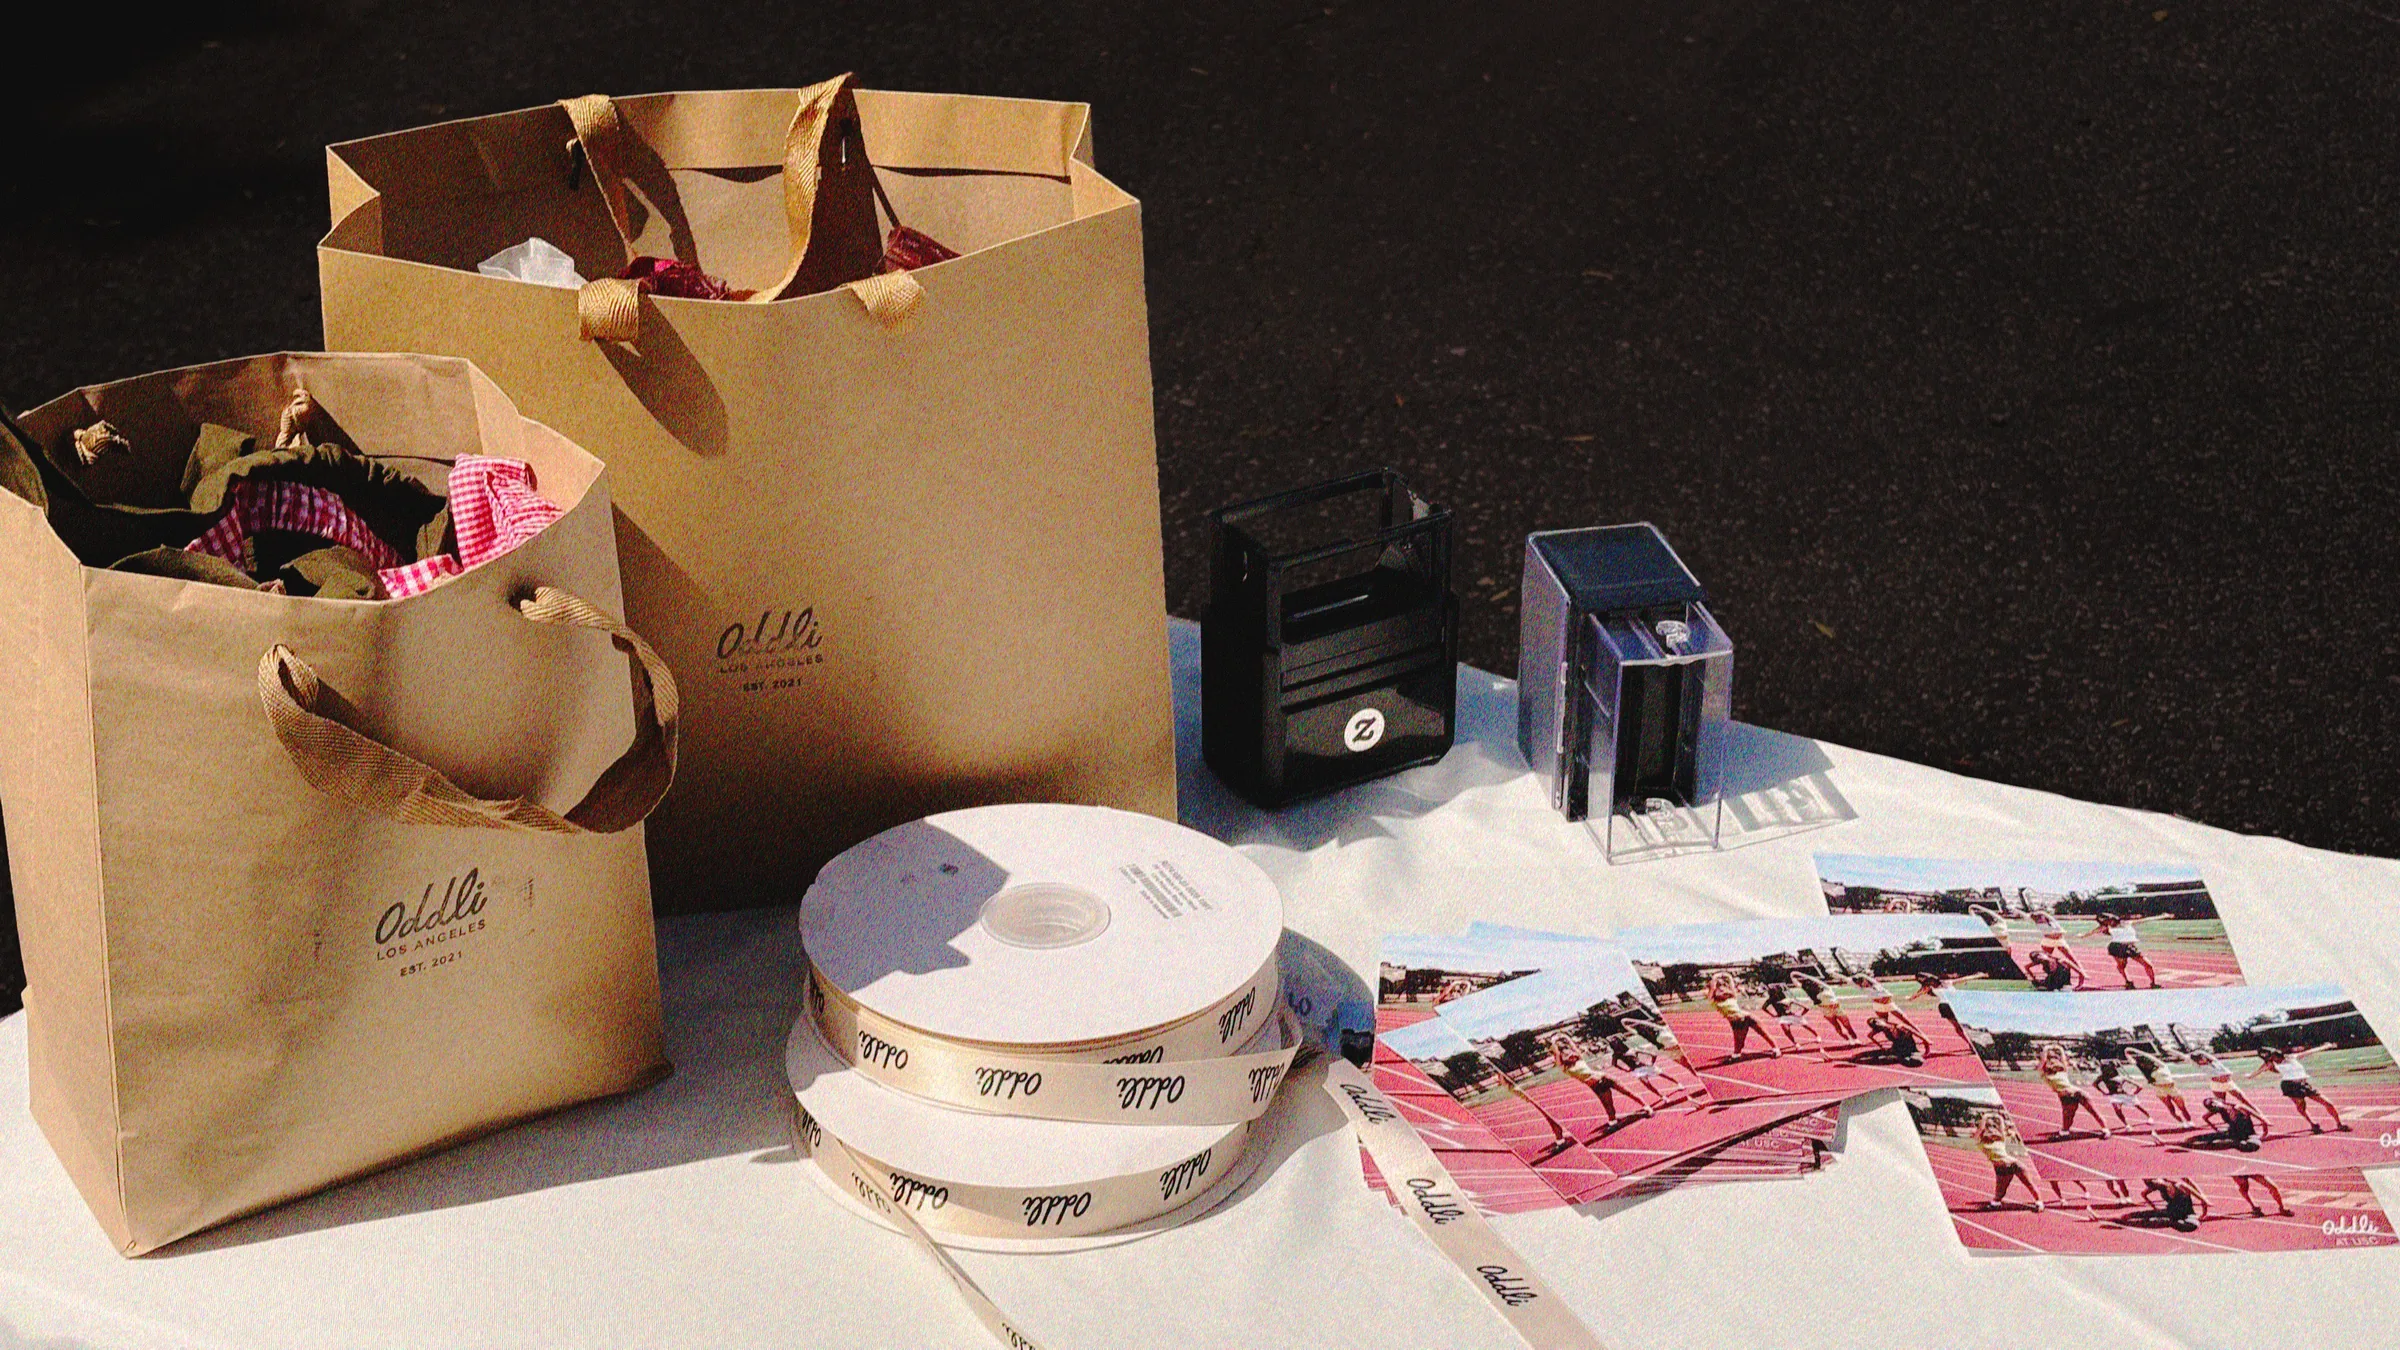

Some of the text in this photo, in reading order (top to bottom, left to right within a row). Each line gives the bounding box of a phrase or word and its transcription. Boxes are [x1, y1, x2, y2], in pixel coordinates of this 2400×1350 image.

[717, 605, 823, 659] Oddli
[375, 867, 488, 945] Oddli
[377, 918, 486, 961] LOS ANGELES
[400, 950, 463, 977] EST. 2021
[1218, 986, 1256, 1043] Oddli
[859, 1030, 909, 1069] Oddli
[975, 1066, 1042, 1099] Oddli
[1117, 1075, 1185, 1110] Oddli
[1340, 1083, 1397, 1125] Oddli
[889, 1172, 949, 1211] Oddli
[1159, 1147, 1212, 1201] Oddli
[1022, 1191, 1092, 1227] Oddli
[1406, 1177, 1464, 1225] Oddli
[2322, 1214, 2379, 1235] Oddli
[1476, 1265, 1538, 1307] Oddli
